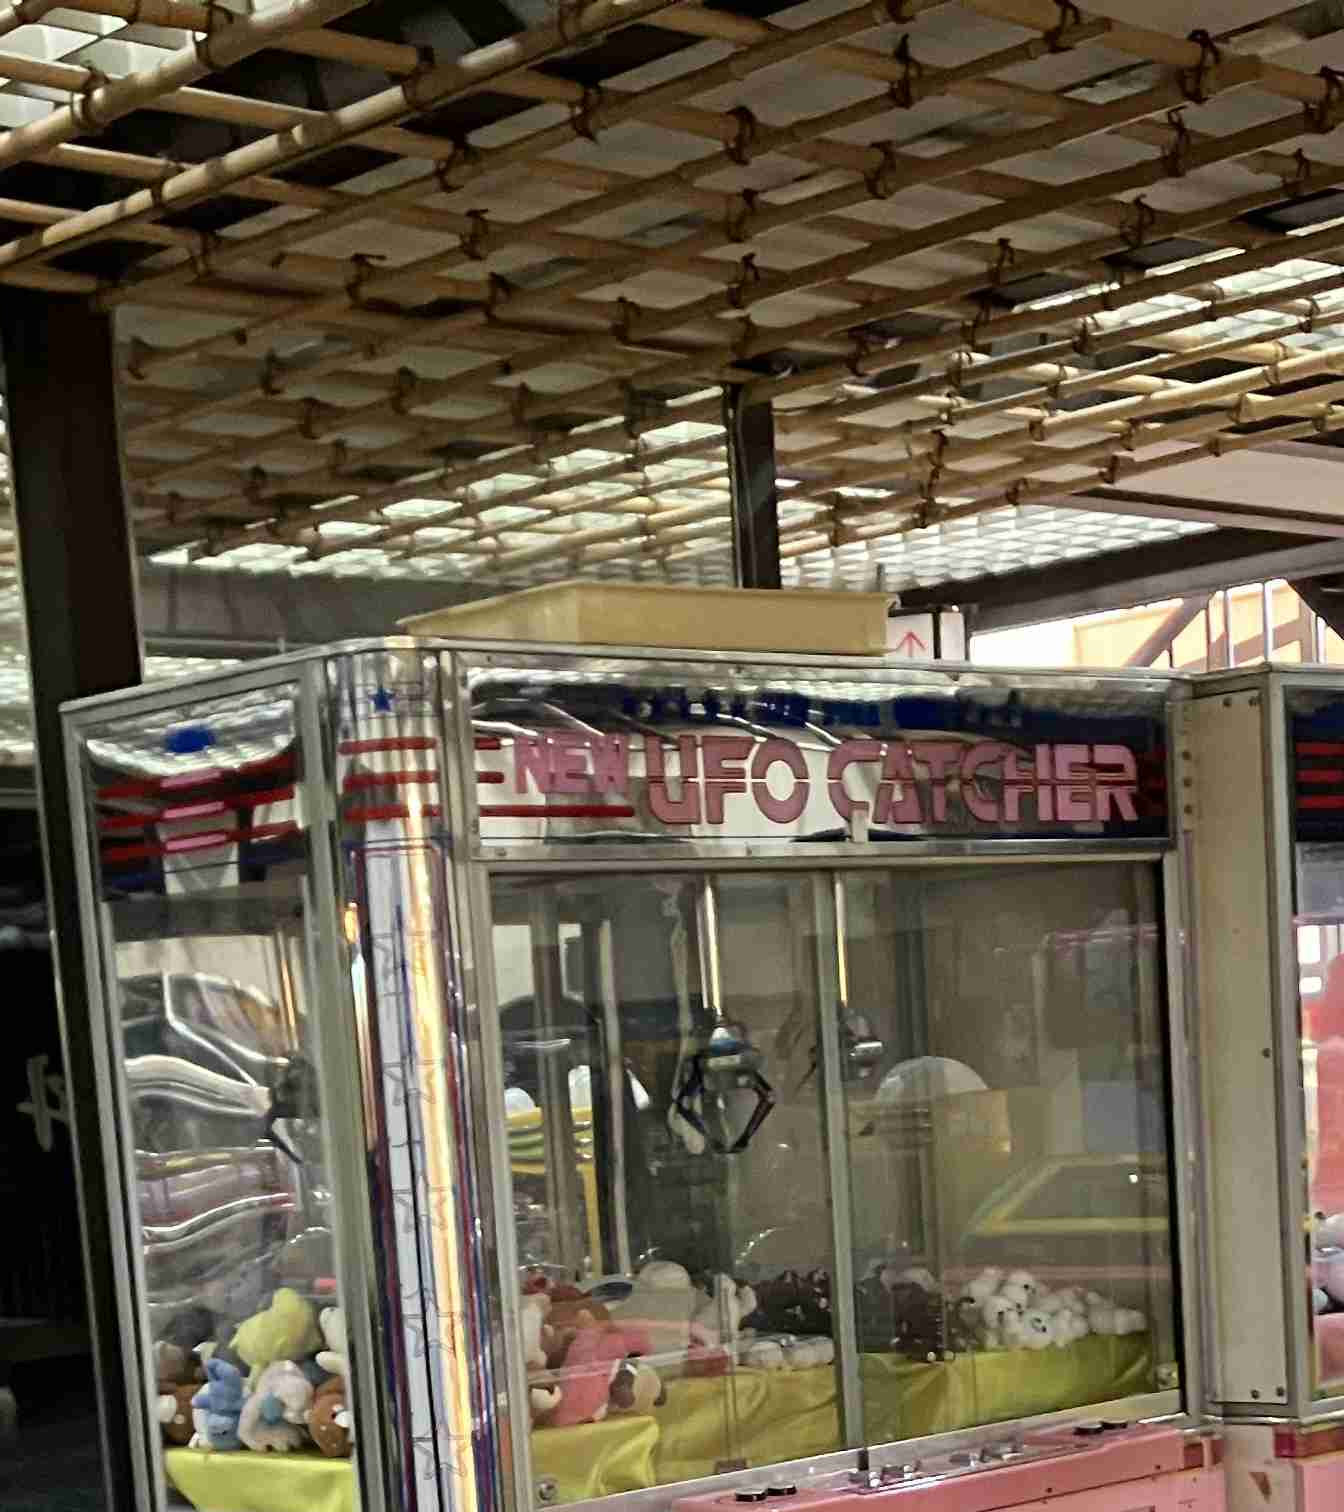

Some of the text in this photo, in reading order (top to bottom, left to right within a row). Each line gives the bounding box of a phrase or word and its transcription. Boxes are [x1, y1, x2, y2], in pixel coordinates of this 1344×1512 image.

[513, 731, 1140, 825] NEW UFO CATCHER
